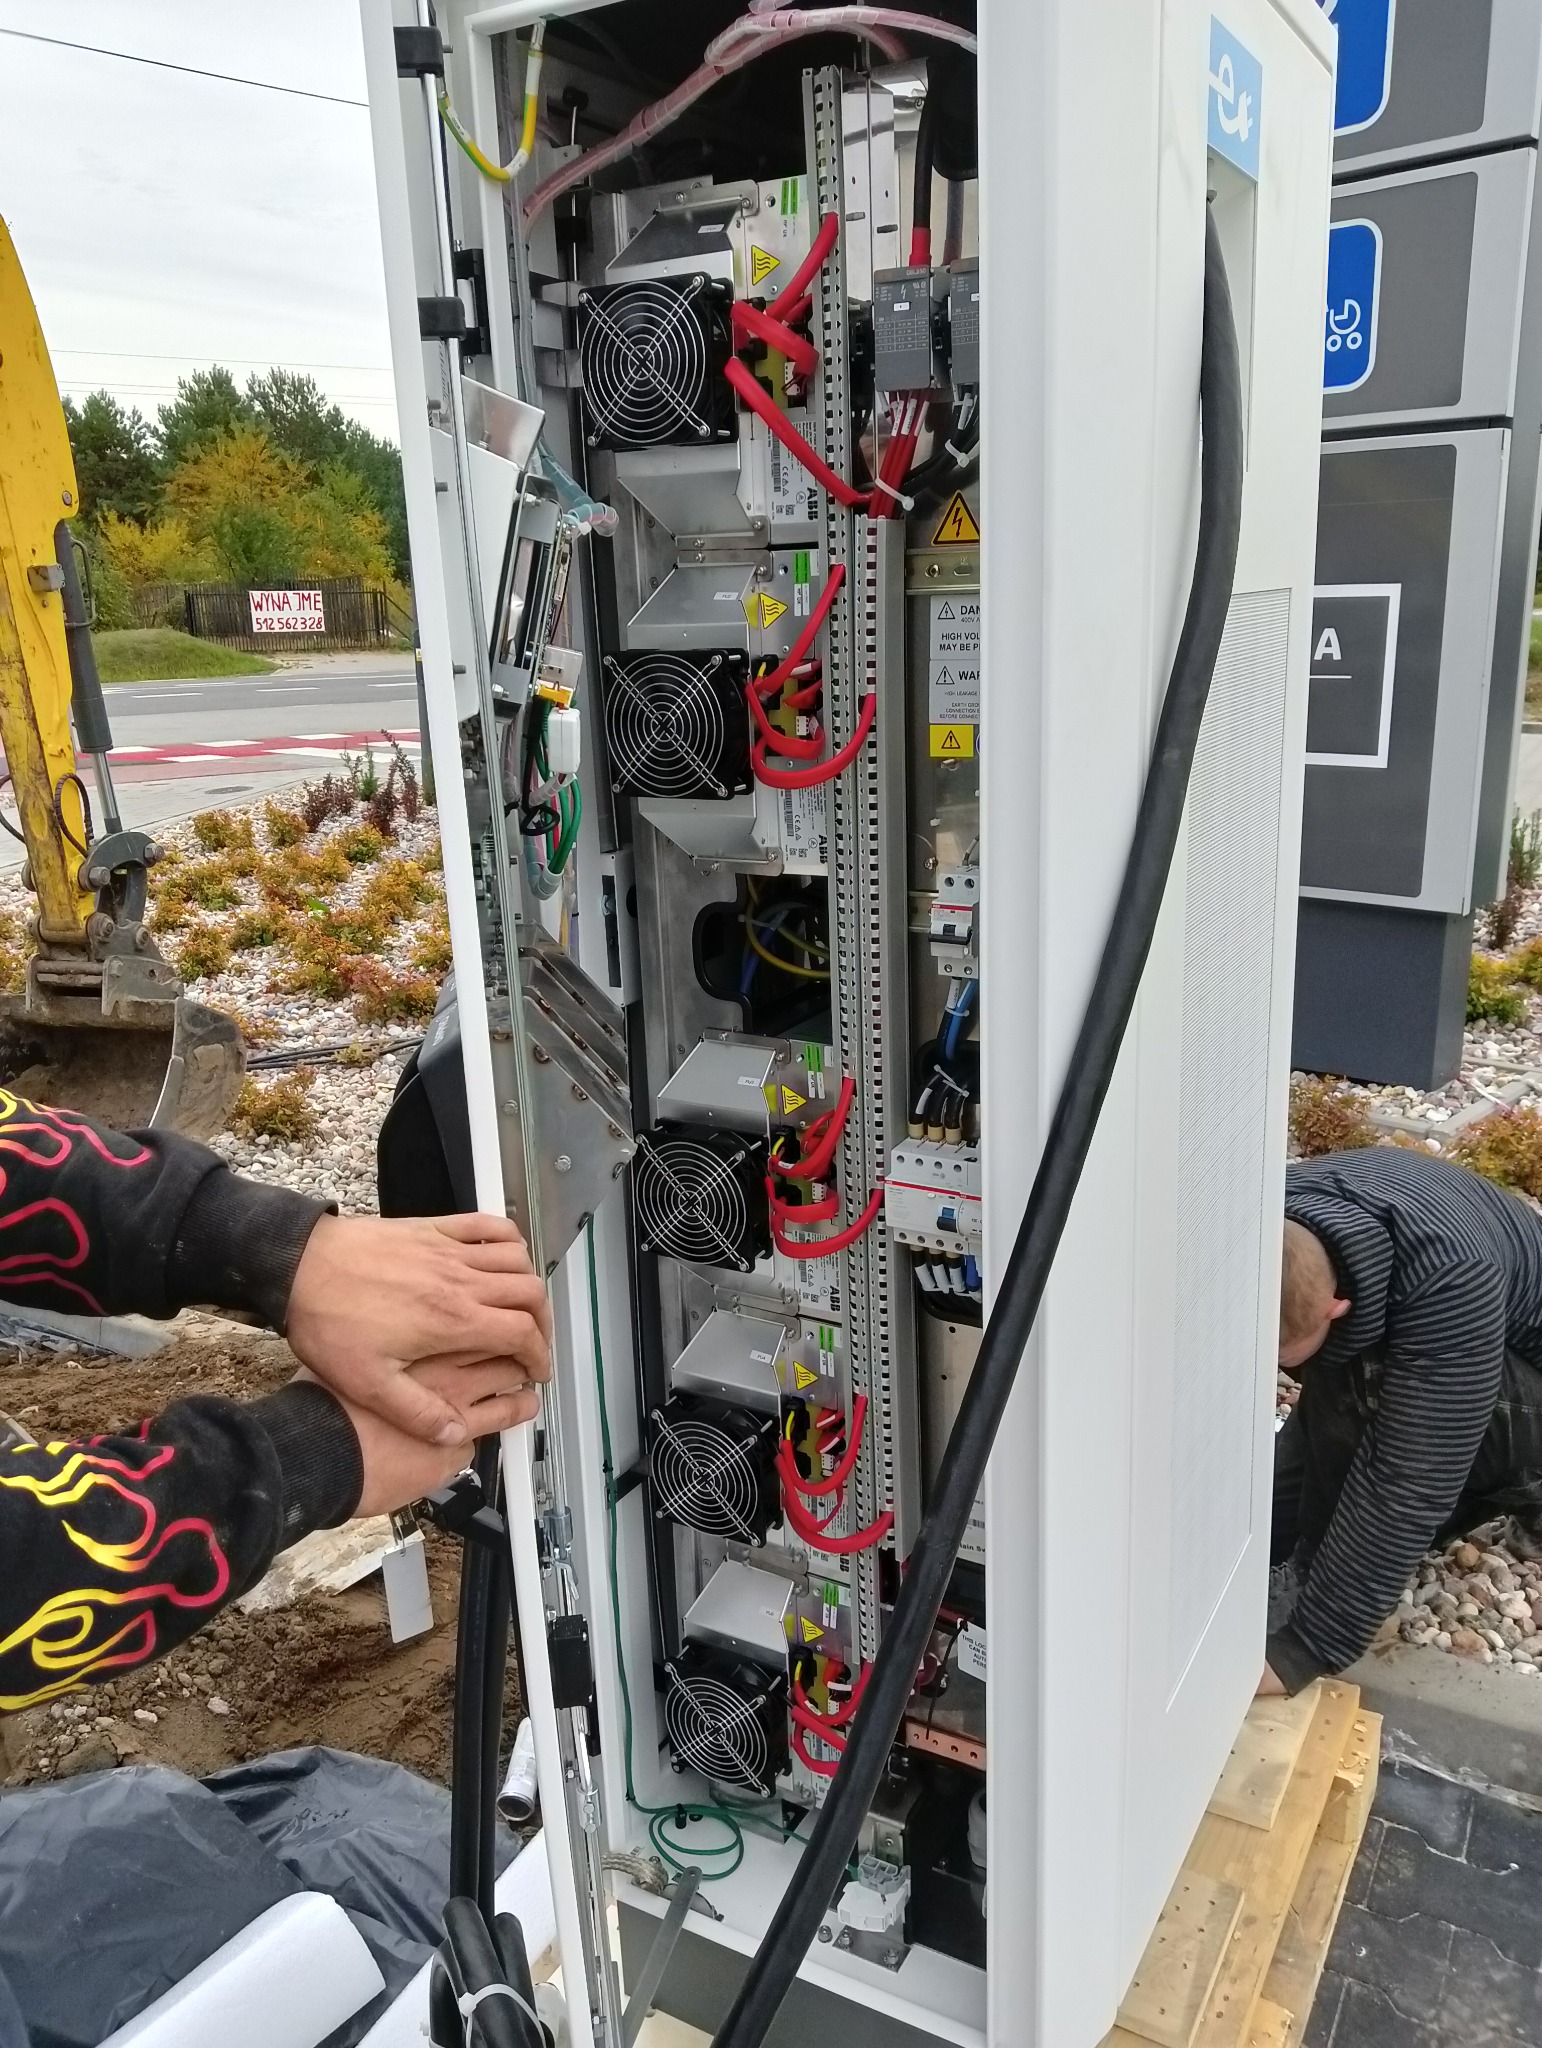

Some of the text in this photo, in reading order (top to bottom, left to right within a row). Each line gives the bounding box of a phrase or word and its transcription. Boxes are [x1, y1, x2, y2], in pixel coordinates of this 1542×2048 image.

[807, 487, 819, 521] ABB
[941, 632, 962, 641] HIGH
[939, 643, 957, 652] MAY
[959, 643, 971, 652] BE
[829, 1285, 841, 1312] ABB
[840, 1552, 850, 1573] BB
